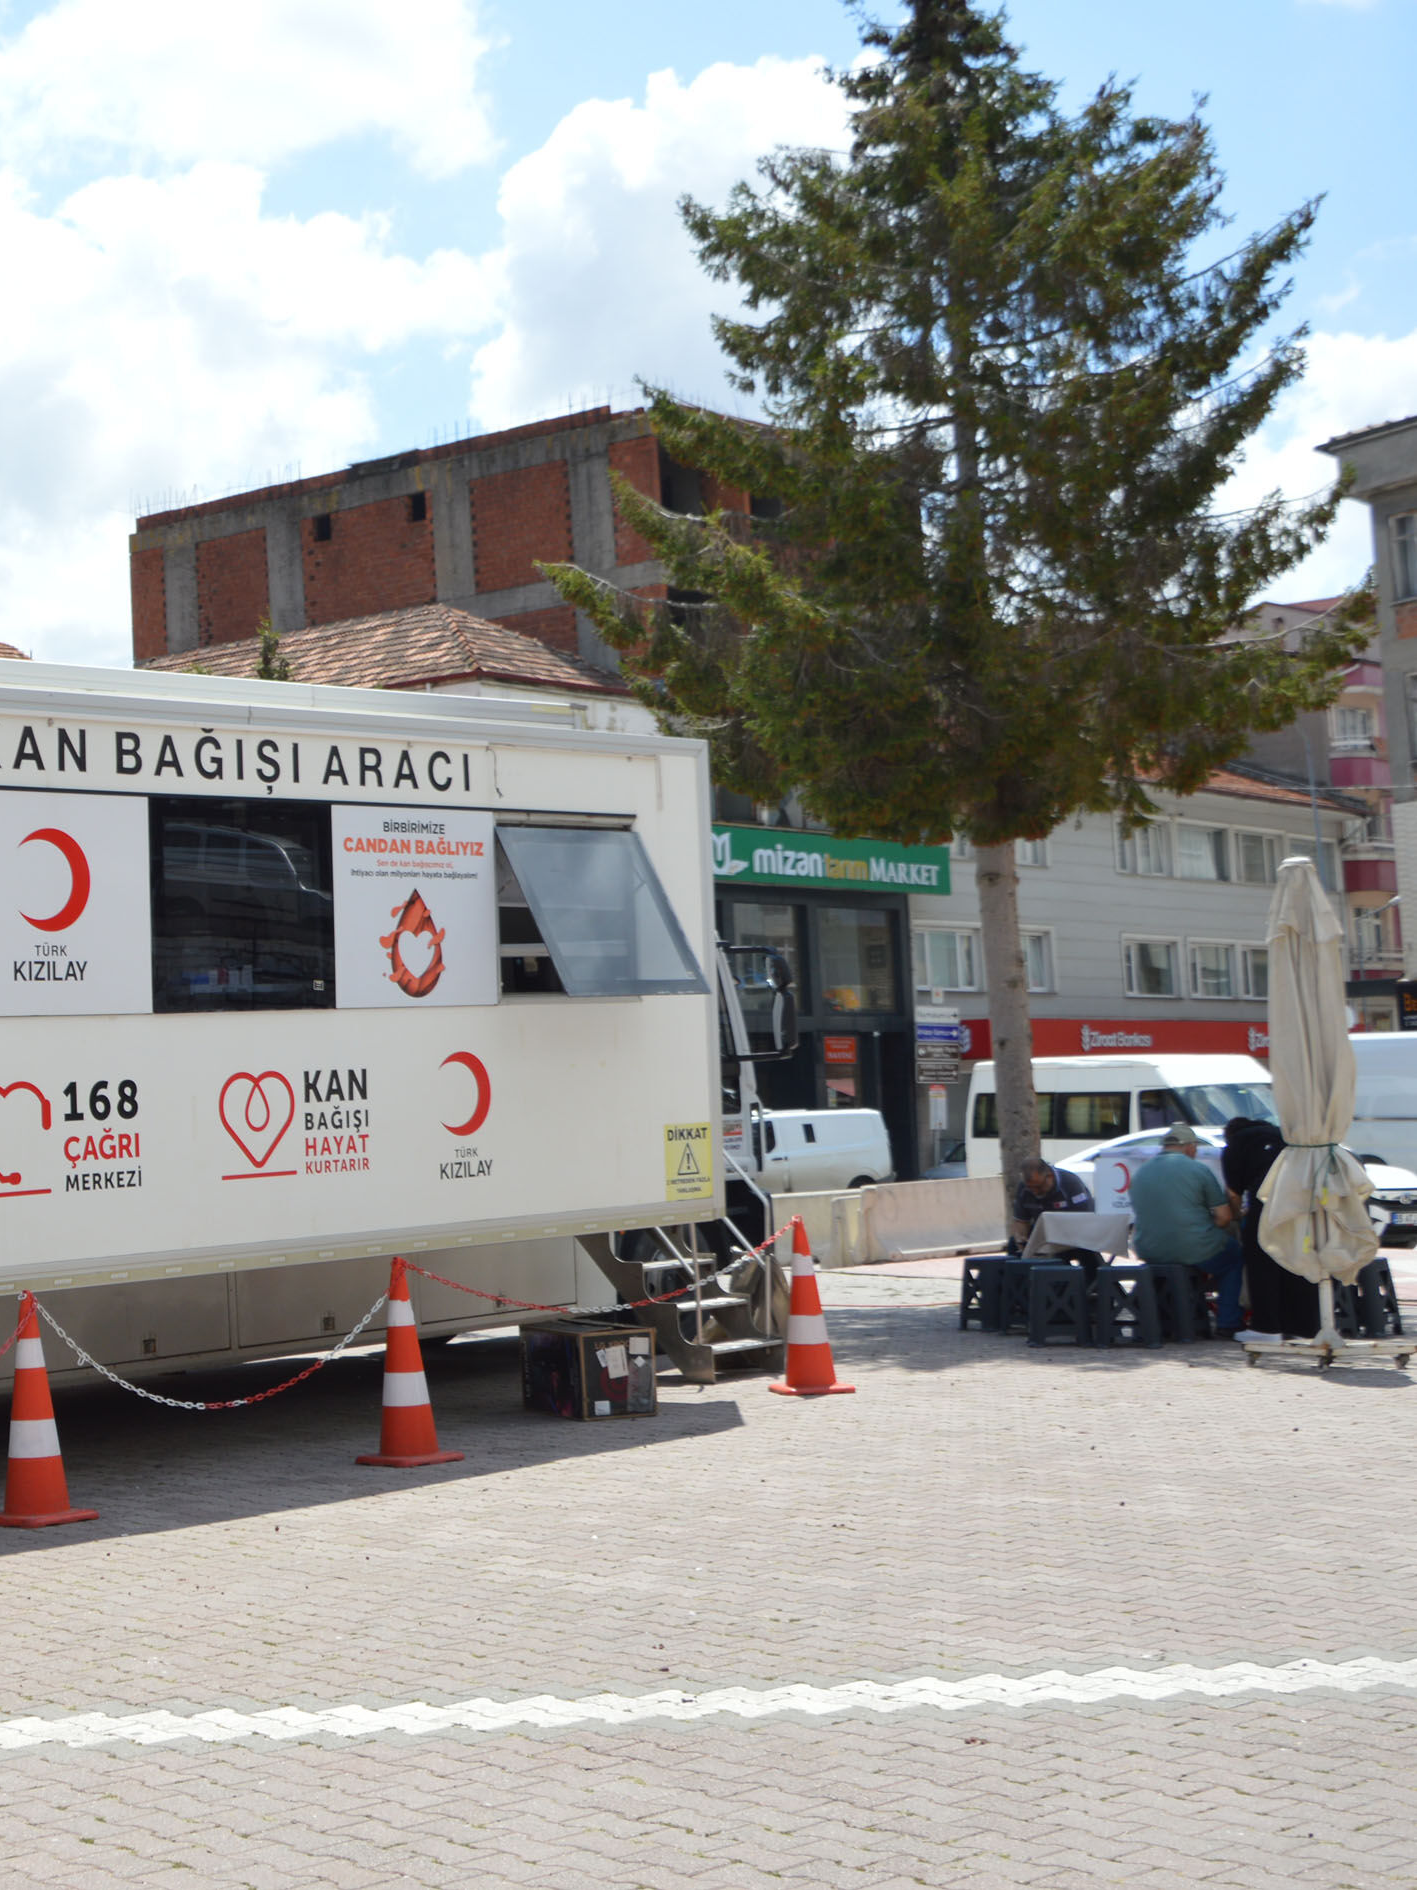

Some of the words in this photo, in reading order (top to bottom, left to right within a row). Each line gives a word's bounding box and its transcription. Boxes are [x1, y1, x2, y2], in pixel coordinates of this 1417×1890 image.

[115, 727, 302, 795] BAĞIŞI
[321, 743, 471, 792] ARACI
[382, 819, 445, 834] BİRBİRİMİZE
[343, 836, 411, 854] CANDAN
[415, 836, 484, 857] BAĞLIYIZ
[752, 843, 822, 878] mizan
[870, 856, 940, 886] MARKET
[34, 941, 68, 957] TÜRK
[13, 960, 88, 982] KIZILAY
[303, 1068, 368, 1103] KAN
[62, 1079, 139, 1121] 168
[304, 1105, 369, 1133] BAĞIŞI
[667, 1125, 707, 1141] DİKKAT
[63, 1127, 140, 1169] ÇAĞRI
[304, 1133, 370, 1157] HAYAT
[454, 1146, 479, 1158] TÜRK
[305, 1157, 370, 1175] KURTARIR
[439, 1159, 493, 1180] KIZILAY
[65, 1165, 142, 1192] MERKEZİ
